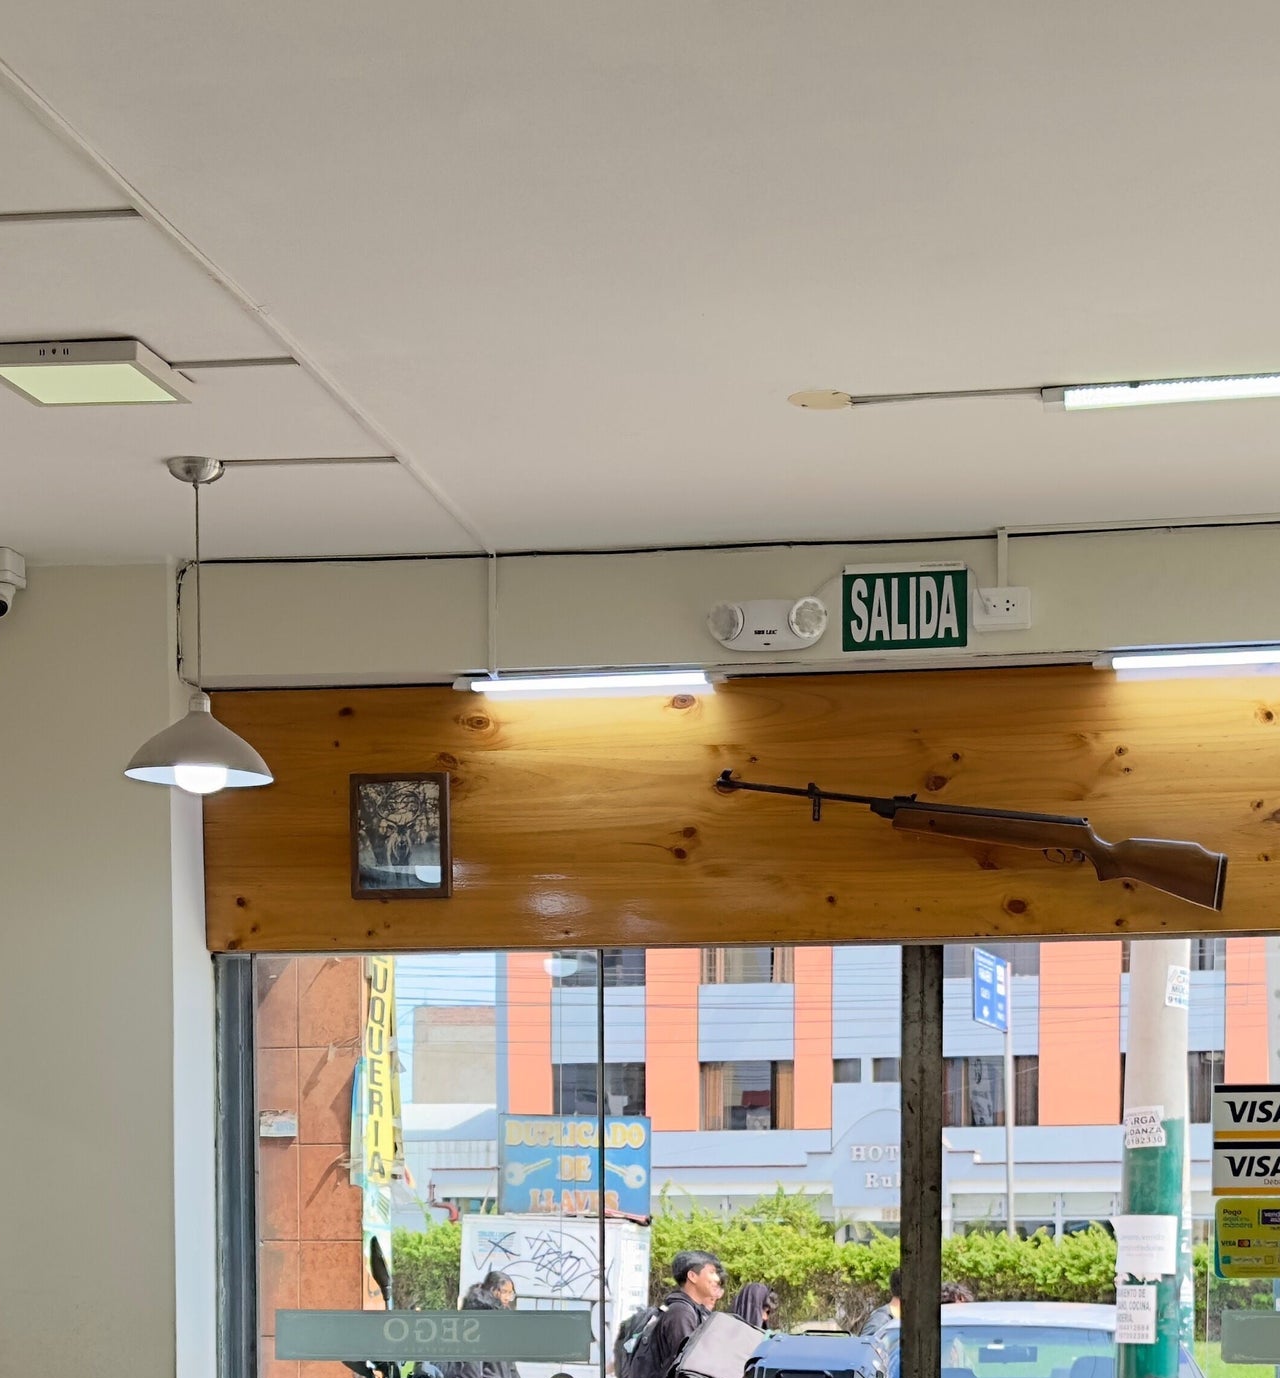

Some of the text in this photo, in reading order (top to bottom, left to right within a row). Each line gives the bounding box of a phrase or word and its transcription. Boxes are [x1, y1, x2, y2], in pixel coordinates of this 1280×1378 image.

[850, 574, 959, 643] SALIDA
[505, 1121, 645, 1148] DUPLICADO
[850, 1145, 899, 1161] HOT
[557, 1155, 592, 1181] DE
